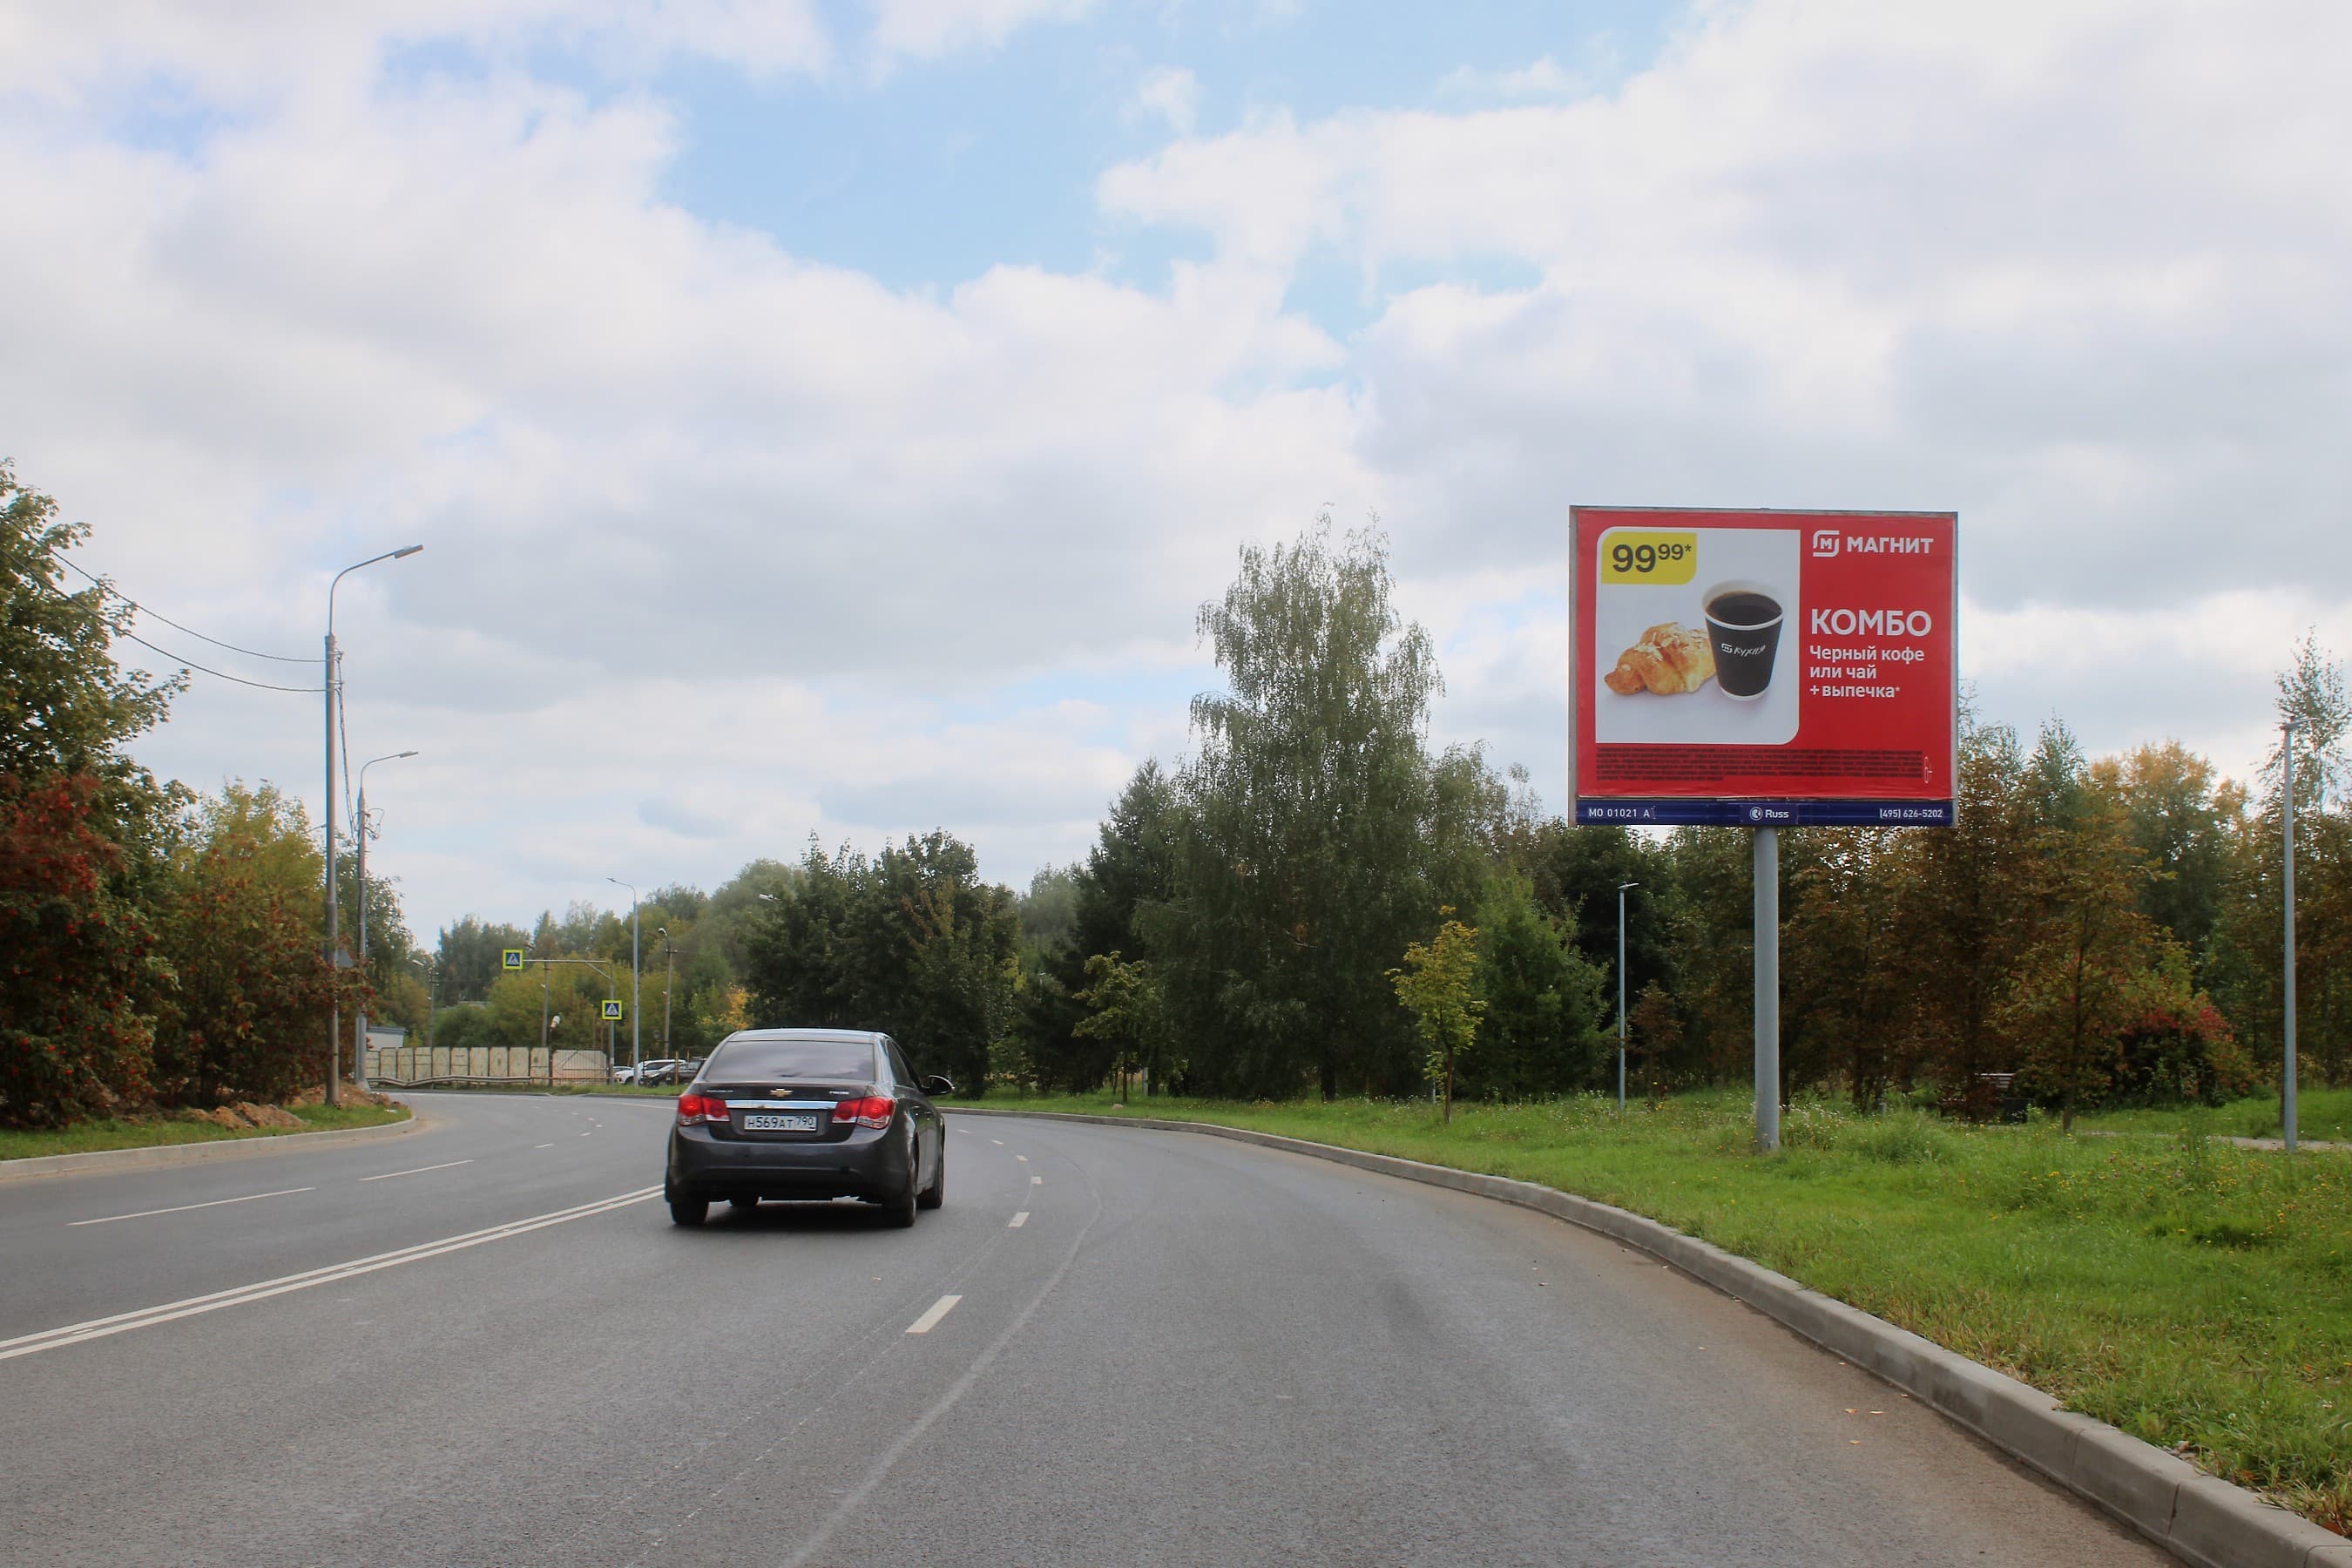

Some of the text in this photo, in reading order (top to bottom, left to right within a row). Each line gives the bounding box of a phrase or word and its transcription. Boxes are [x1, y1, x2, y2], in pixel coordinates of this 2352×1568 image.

[1847, 536, 1934, 554] МАГНИТ
[1811, 608, 1932, 637] КОМБО
[1809, 645, 1924, 665] Черный кофе
[1809, 664, 1876, 679] или чай
[1588, 808, 1604, 817] МО
[1607, 808, 1637, 817] 01021
[1765, 809, 1789, 818] Russ
[1879, 808, 1943, 819] (495) 626-5202
